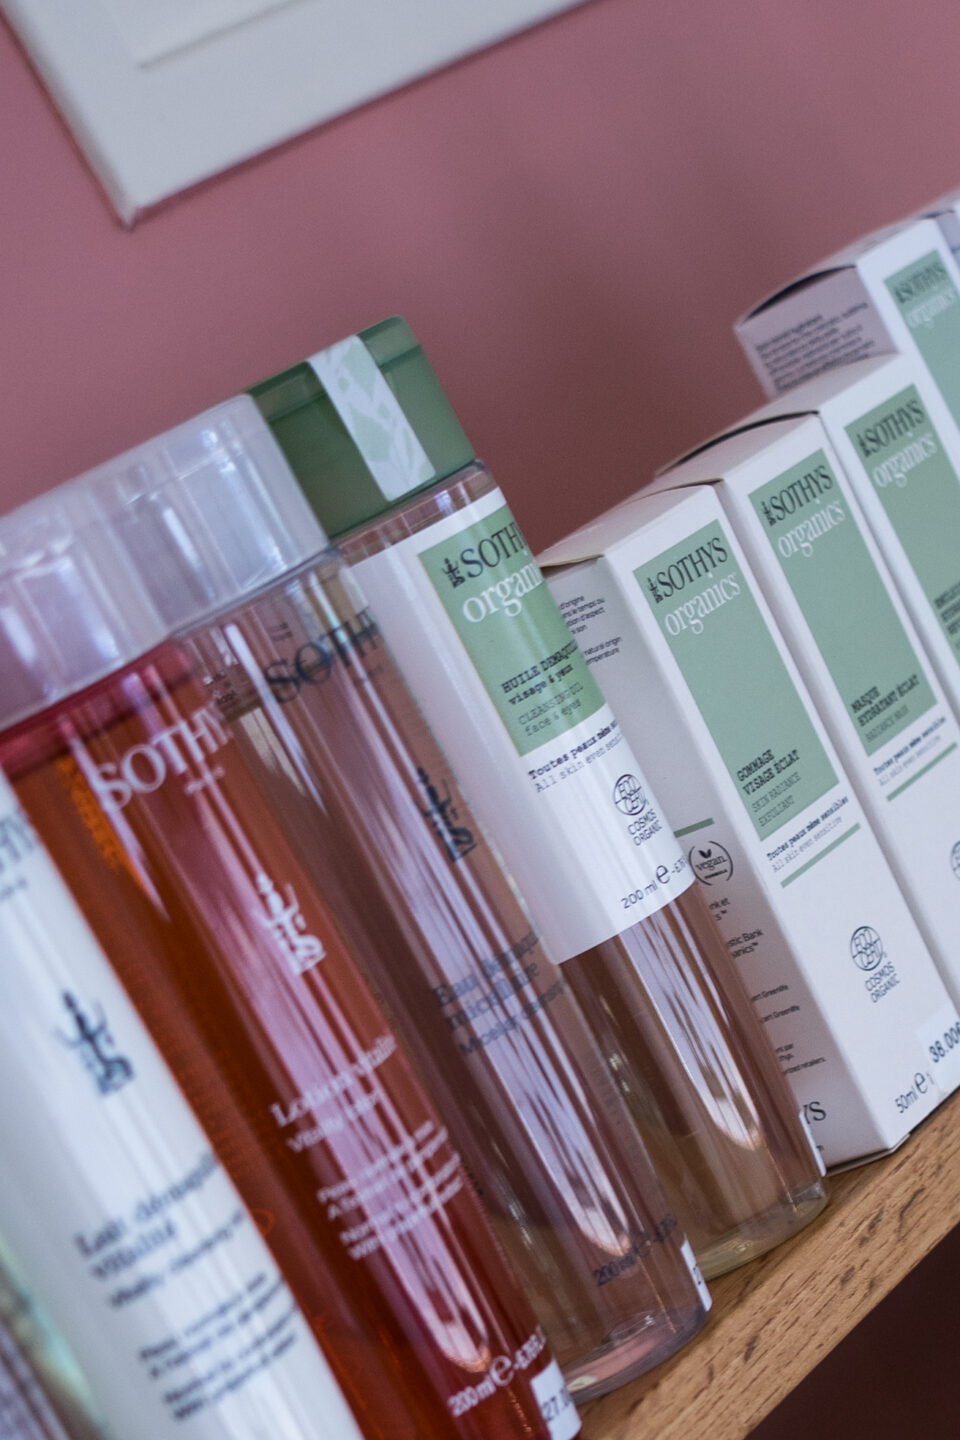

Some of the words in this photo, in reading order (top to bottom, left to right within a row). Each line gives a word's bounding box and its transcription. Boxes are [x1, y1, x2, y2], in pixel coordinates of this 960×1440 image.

[863, 399, 924, 455] SOTHYS
[871, 431, 937, 488] organics
[768, 464, 832, 521] SOTHYS
[777, 498, 845, 558] organics
[655, 536, 728, 597] SOTHYS
[663, 571, 740, 636] organics
[502, 665, 540, 694] HUILE
[509, 679, 546, 705] visage
[528, 755, 569, 781] Toutes
[736, 748, 775, 782] GOMMAGE
[742, 766, 775, 795] VISAGE
[750, 793, 770, 813] SKIN
[628, 809, 656, 836] COSMOS
[634, 820, 663, 847] ORGANIC
[766, 841, 789, 861] Toutes
[787, 828, 807, 847] peaux
[819, 795, 848, 821] sensibles
[621, 887, 644, 909] 200
[864, 960, 895, 992] COSMOS
[869, 972, 900, 1003] ORGANIC
